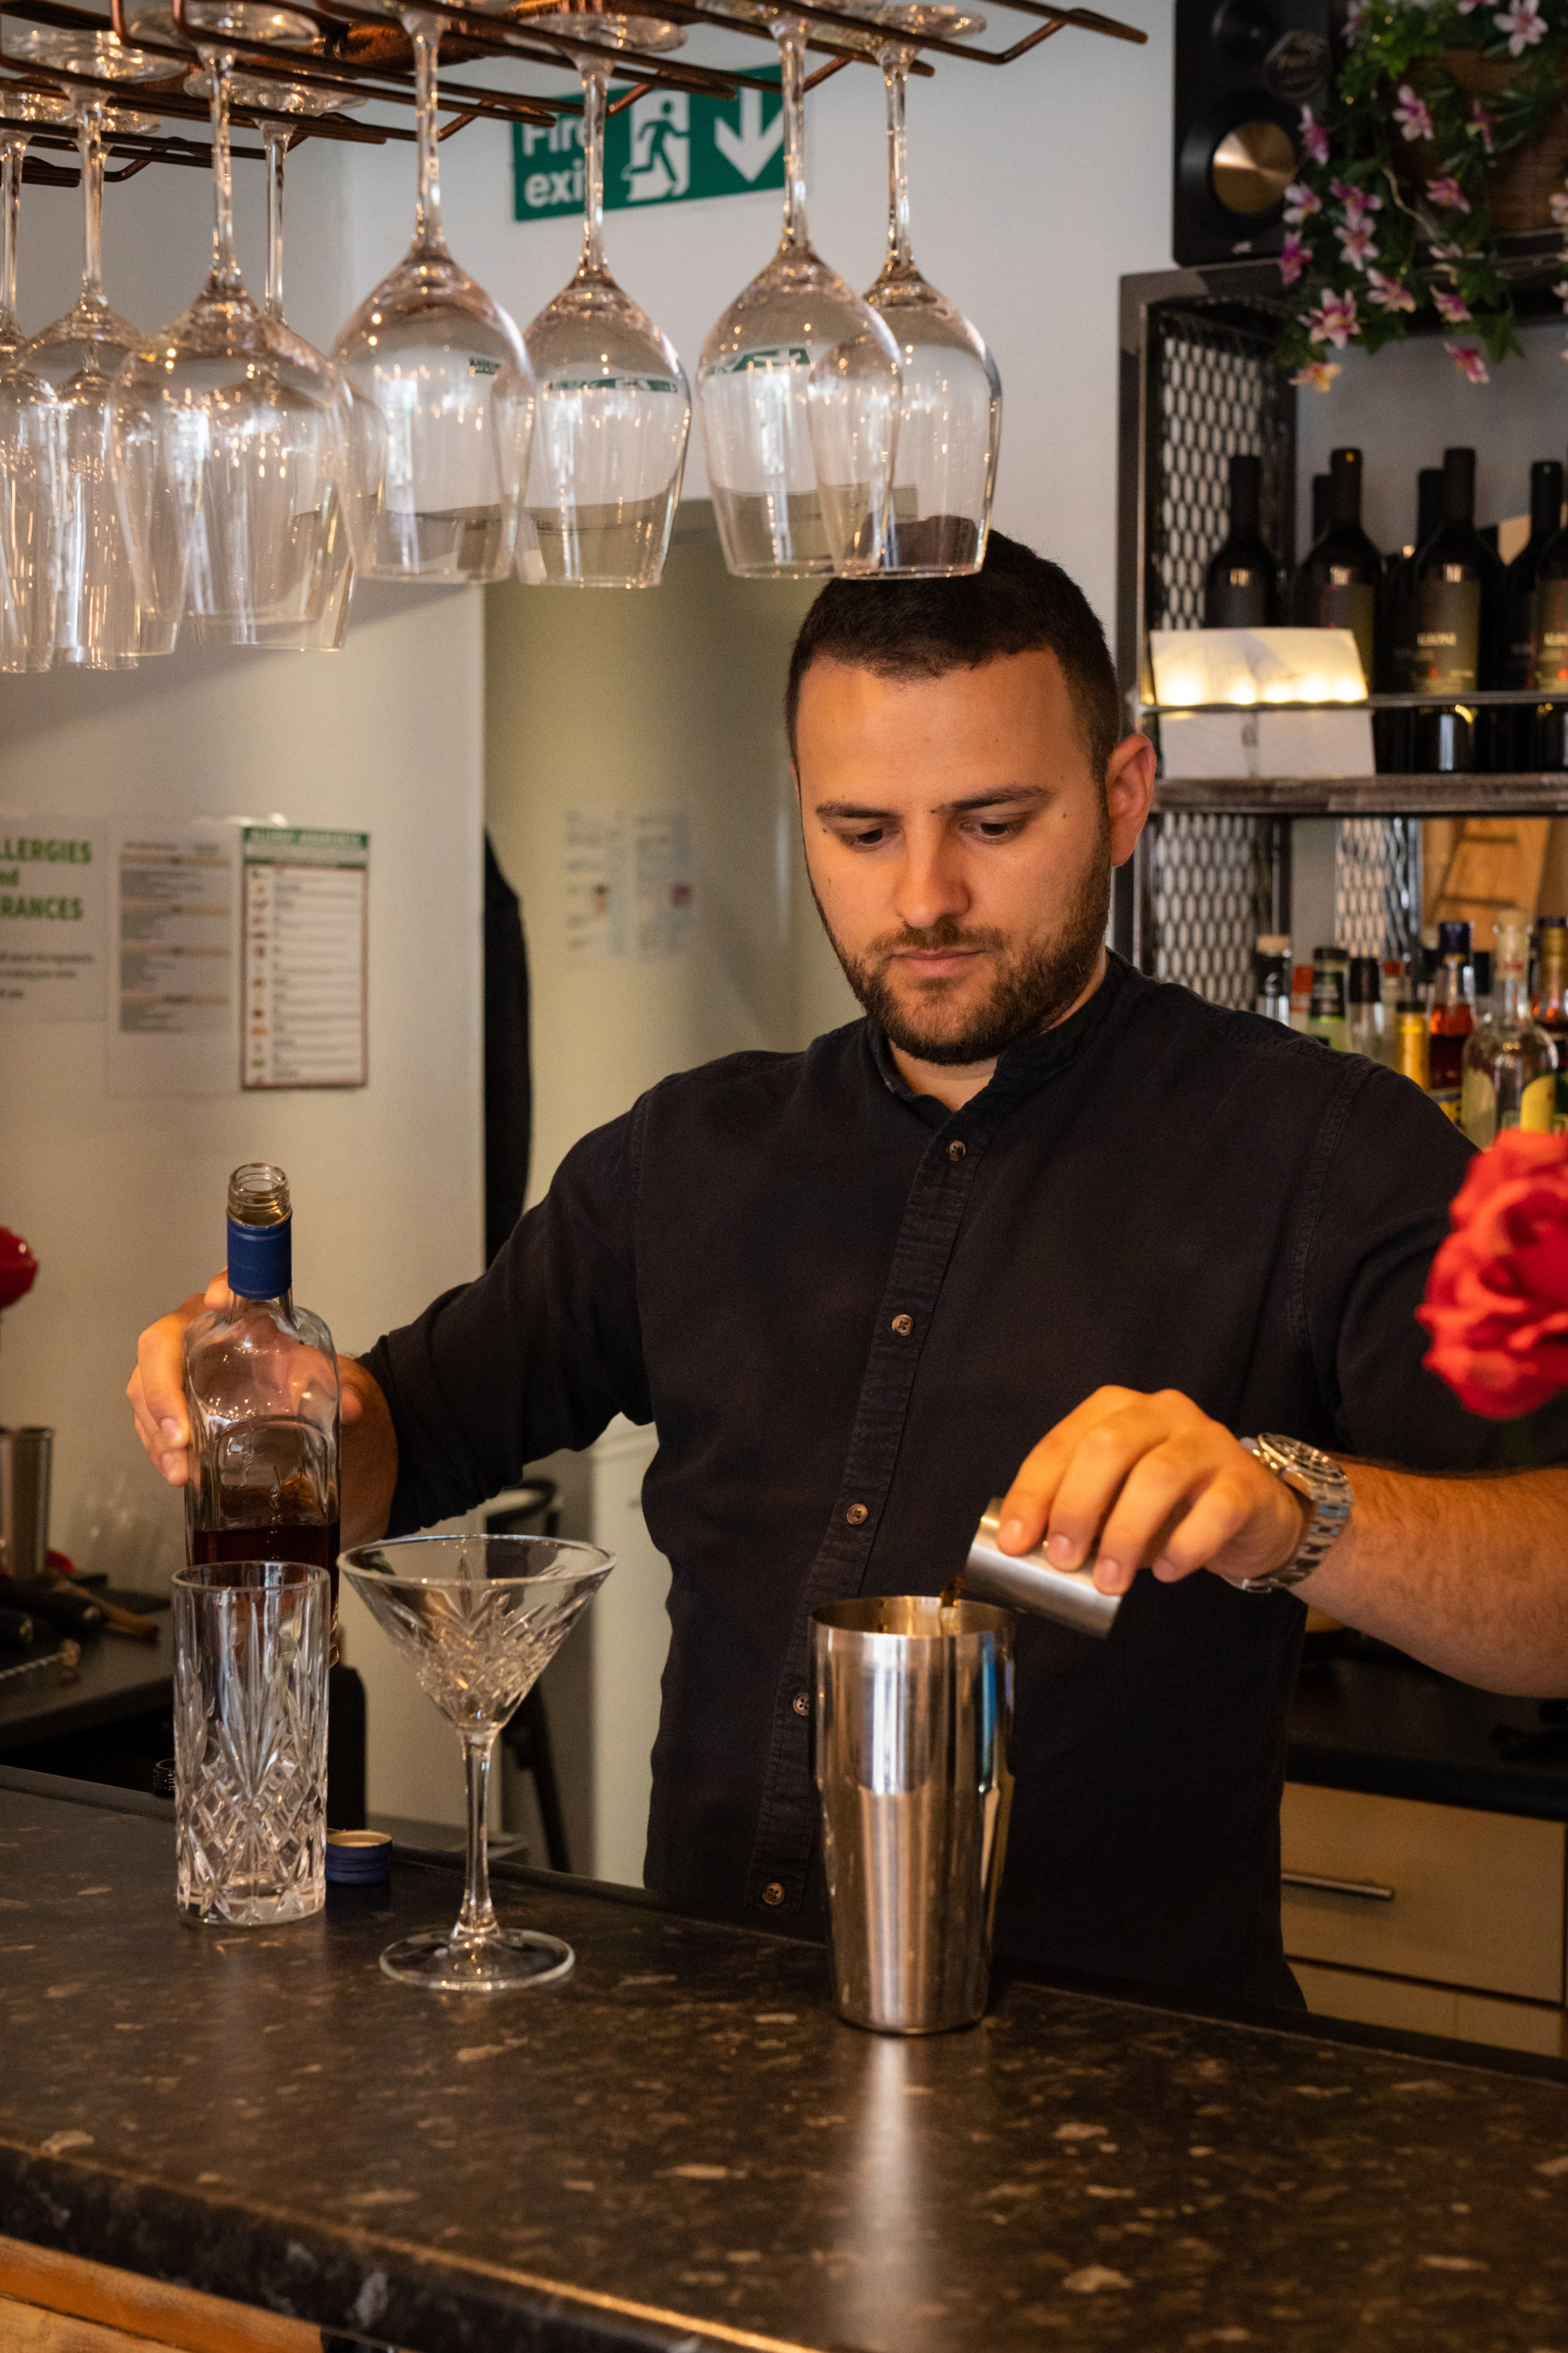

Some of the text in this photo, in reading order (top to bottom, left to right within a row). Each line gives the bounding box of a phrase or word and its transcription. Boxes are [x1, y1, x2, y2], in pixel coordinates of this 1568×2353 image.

[524, 157, 585, 208] exi
[0, 837, 92, 864] LERGIES
[0, 894, 83, 921] RANCES
